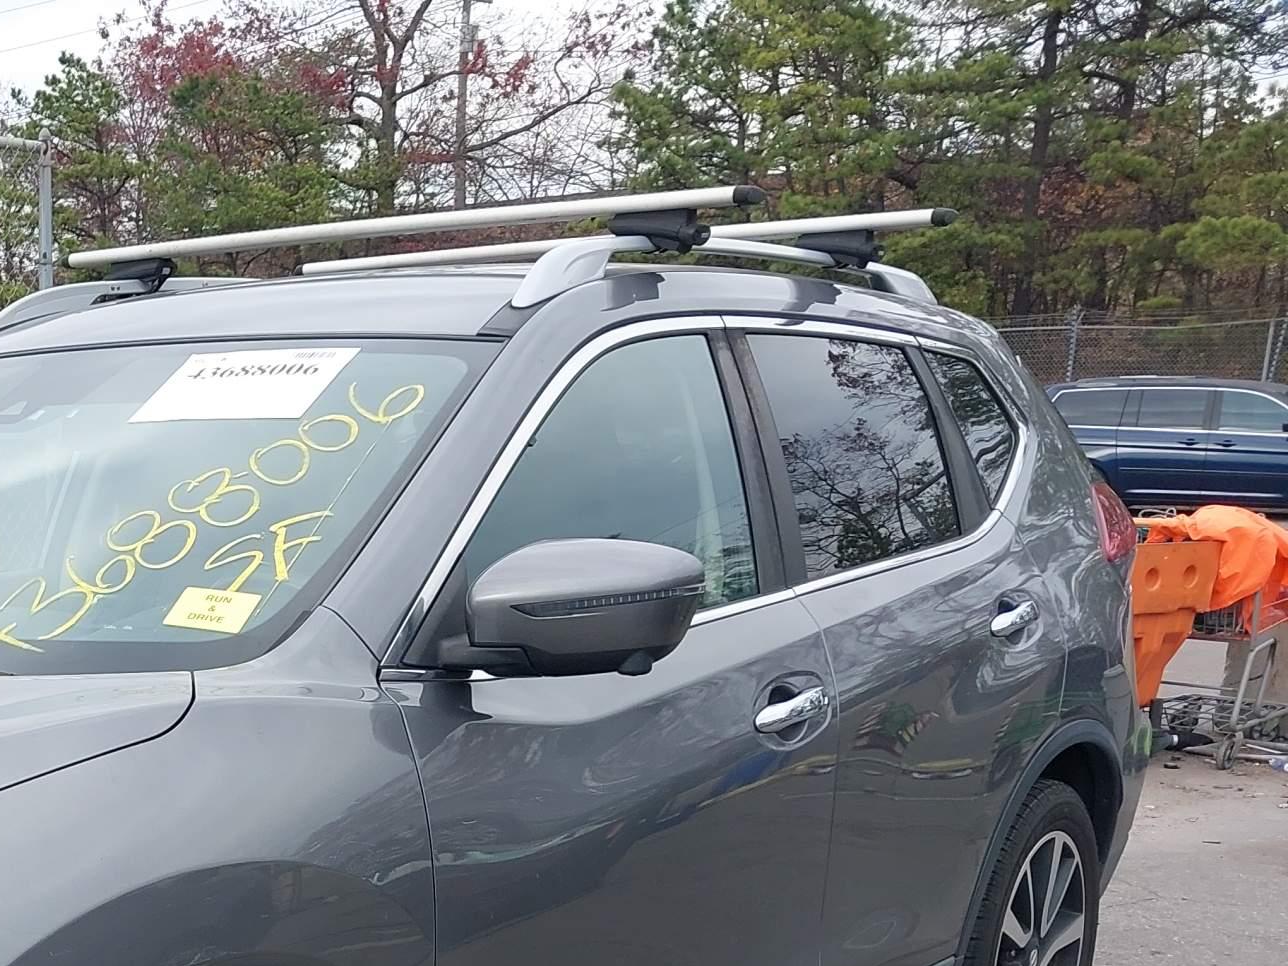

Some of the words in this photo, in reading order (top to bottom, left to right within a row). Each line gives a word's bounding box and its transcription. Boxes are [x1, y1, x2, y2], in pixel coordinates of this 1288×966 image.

[187, 363, 320, 379] 43688006
[203, 510, 335, 593] SF
[205, 594, 233, 604] RUN
[186, 612, 225, 624] DRIVE
